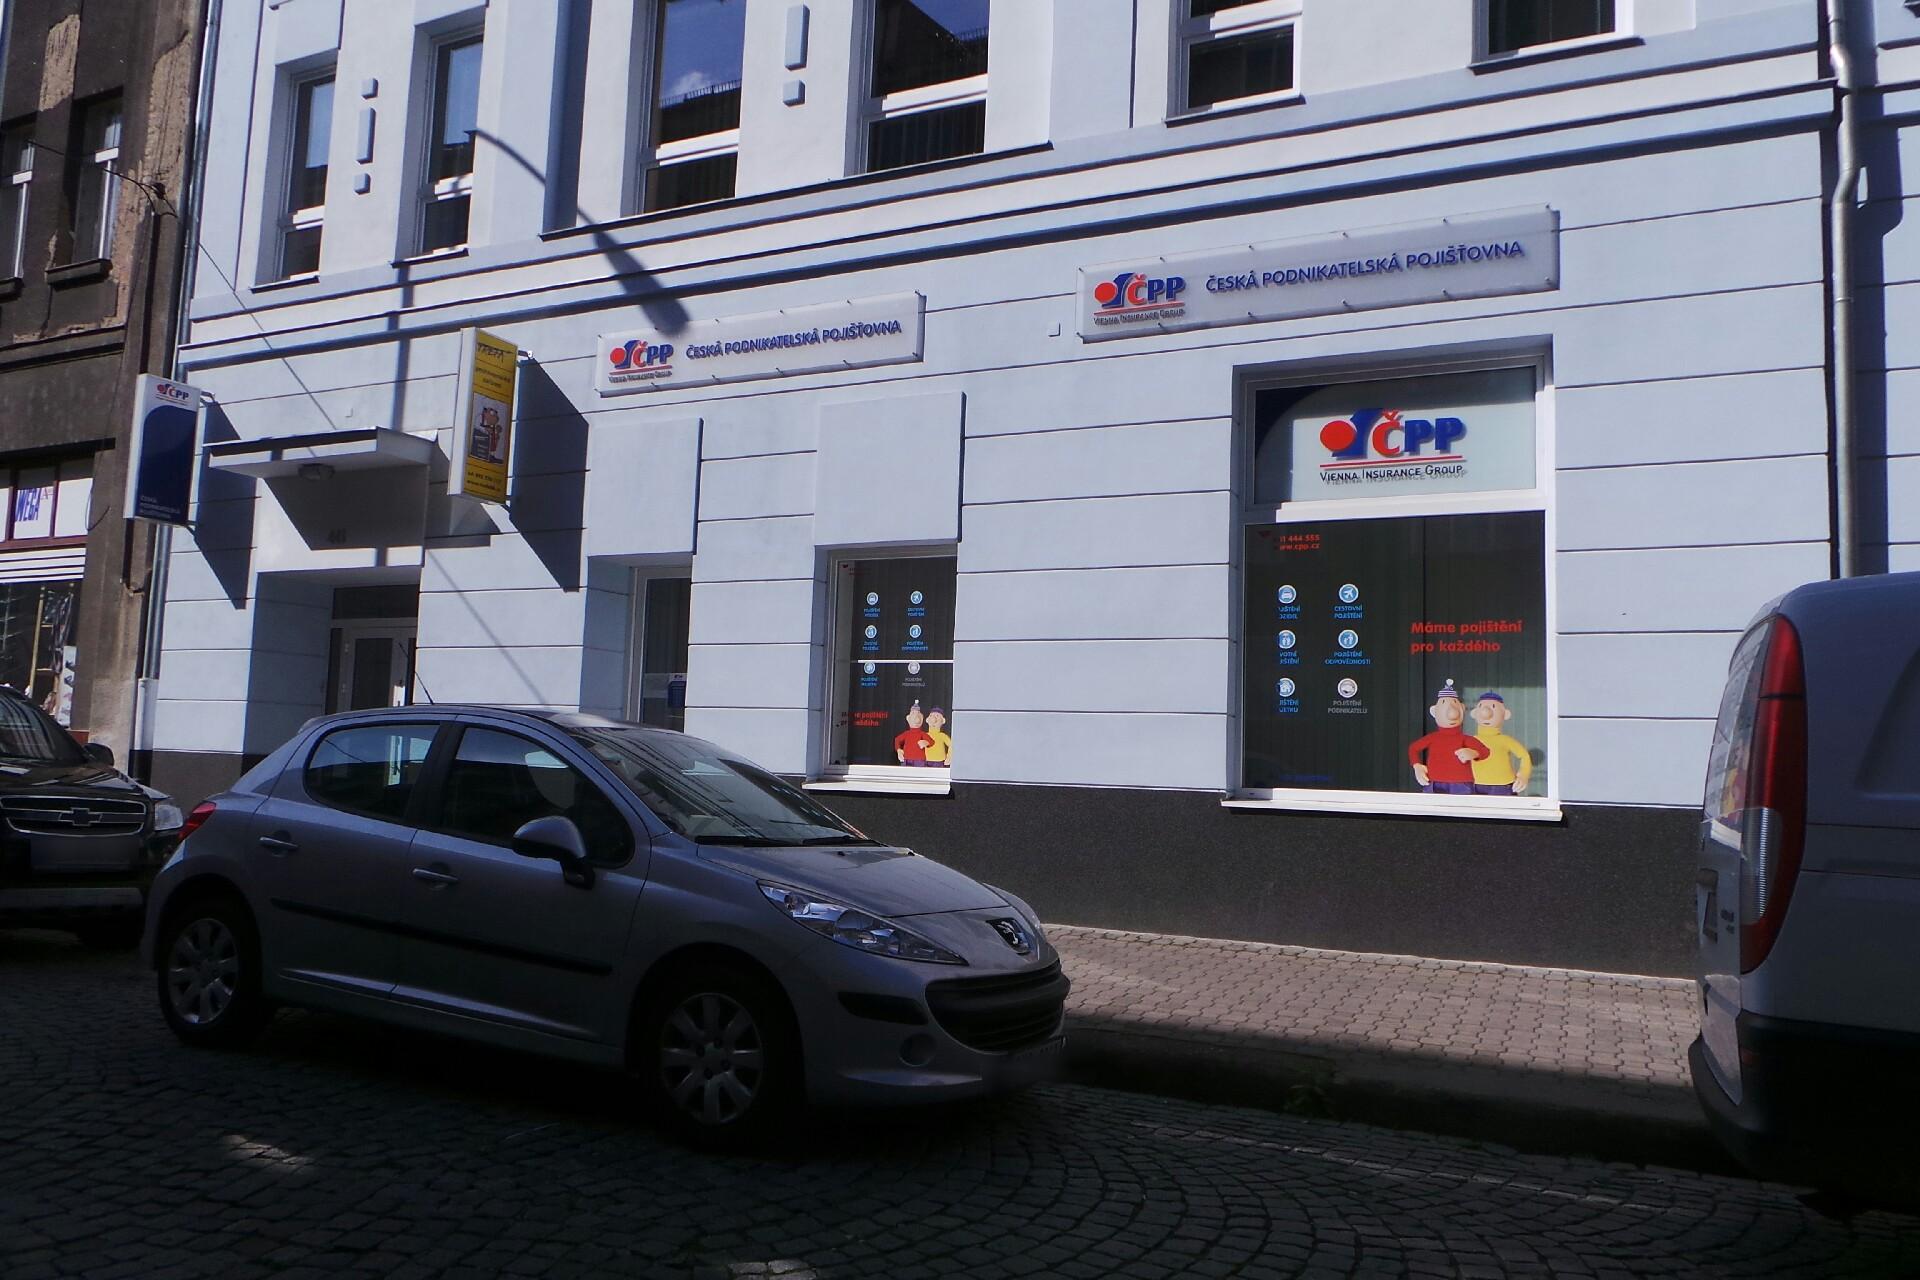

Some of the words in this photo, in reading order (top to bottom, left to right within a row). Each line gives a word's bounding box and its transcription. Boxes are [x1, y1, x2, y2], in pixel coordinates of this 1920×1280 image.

[1205, 270, 1259, 293] ČESKÁ
[1262, 253, 1401, 287] PODNIKATELSKÁ
[1406, 240, 1524, 268] POJIŠŤOVNA
[1127, 273, 1186, 306] ČPP
[633, 340, 674, 367] ČPP
[686, 340, 723, 360] ČESKÁ
[725, 328, 821, 354] PODNIKATELSKÁ
[822, 319, 902, 342] POJIŠŤOVNA
[1372, 409, 1466, 458] ČPP
[1320, 472, 1359, 482] VIENNA
[1362, 467, 1421, 479] INSURANCE
[1425, 464, 1463, 475] GROUP
[1411, 622, 1456, 634] Máme
[1460, 620, 1523, 636] pojištění
[1410, 642, 1434, 655] pro
[1439, 639, 1501, 652] každého
